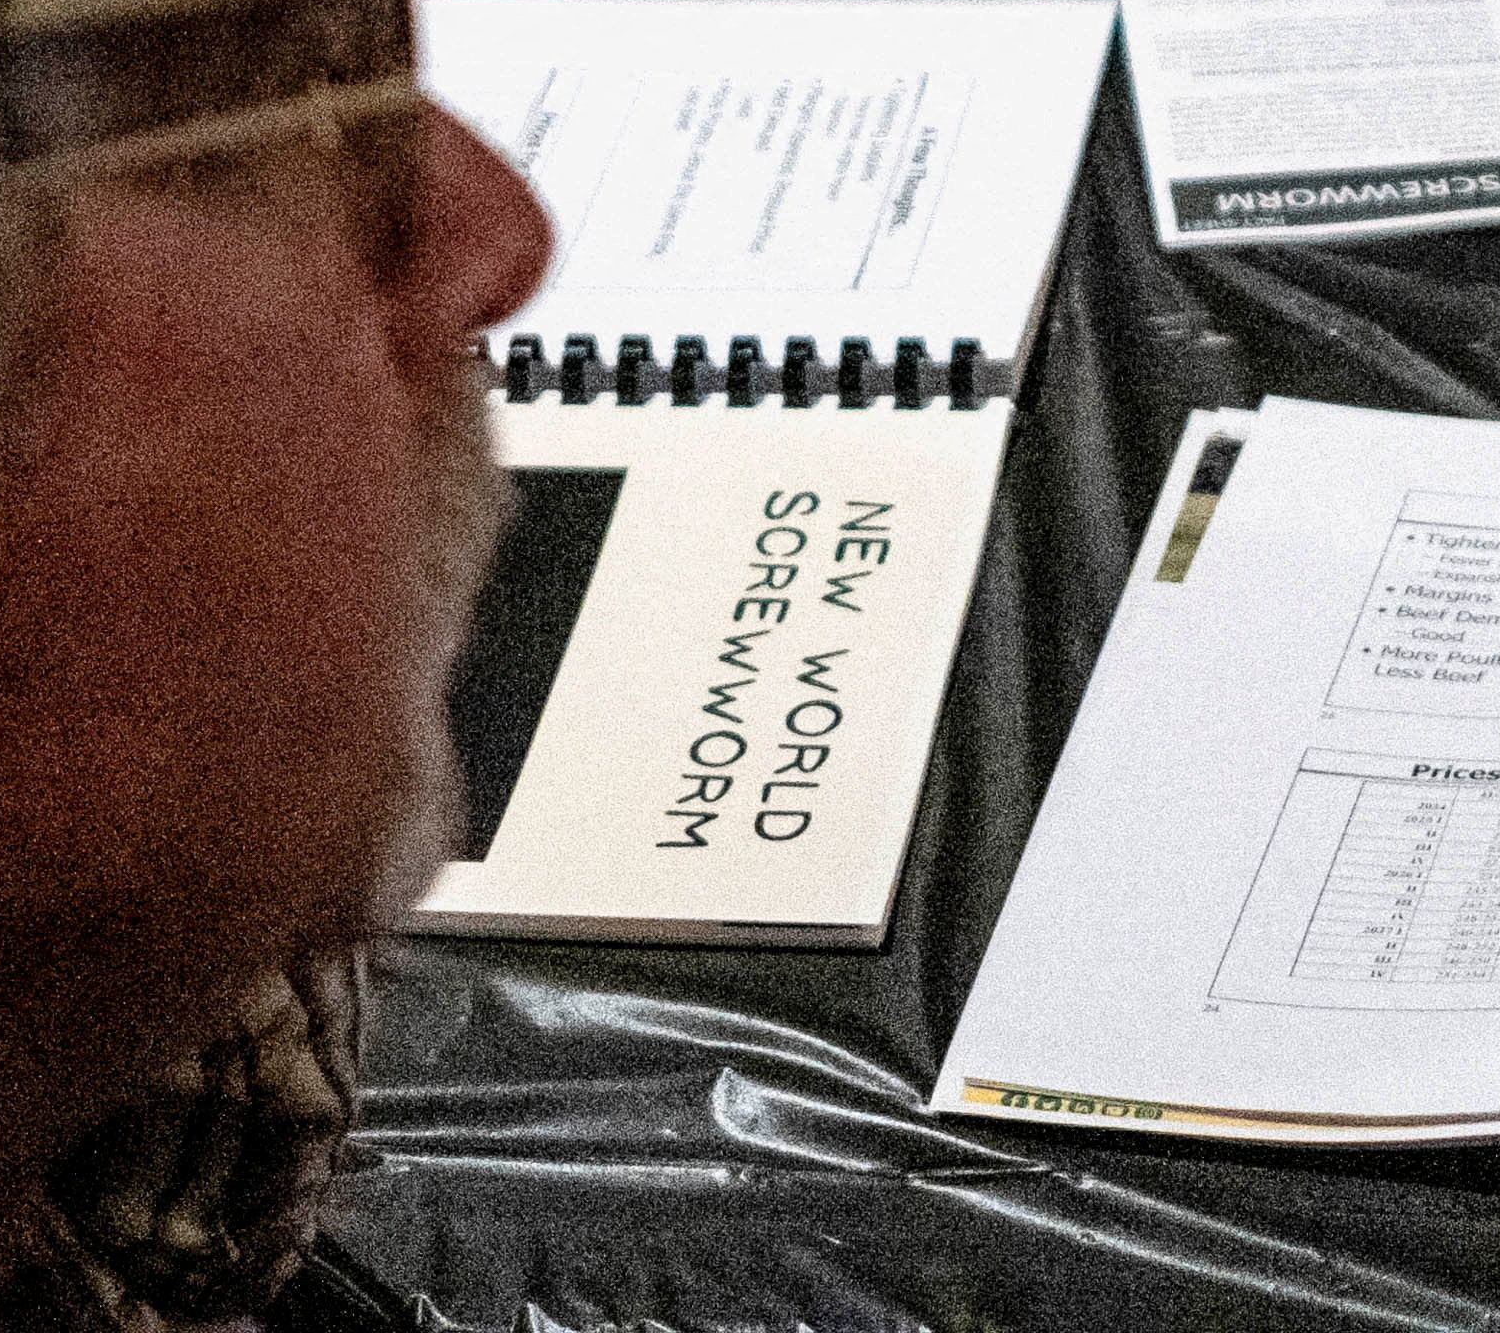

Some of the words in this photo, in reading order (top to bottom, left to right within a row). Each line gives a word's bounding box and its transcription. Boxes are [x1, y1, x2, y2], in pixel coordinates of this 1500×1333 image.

[819, 497, 896, 613] NEW
[1403, 584, 1494, 605] Margins
[1394, 604, 1446, 621] Beef
[1411, 628, 1466, 643] Good
[1380, 644, 1439, 663] More
[655, 490, 821, 851] SCREWWORM
[1373, 663, 1424, 681] Less
[1431, 668, 1486, 684] Beef
[753, 646, 850, 843] WORLD
